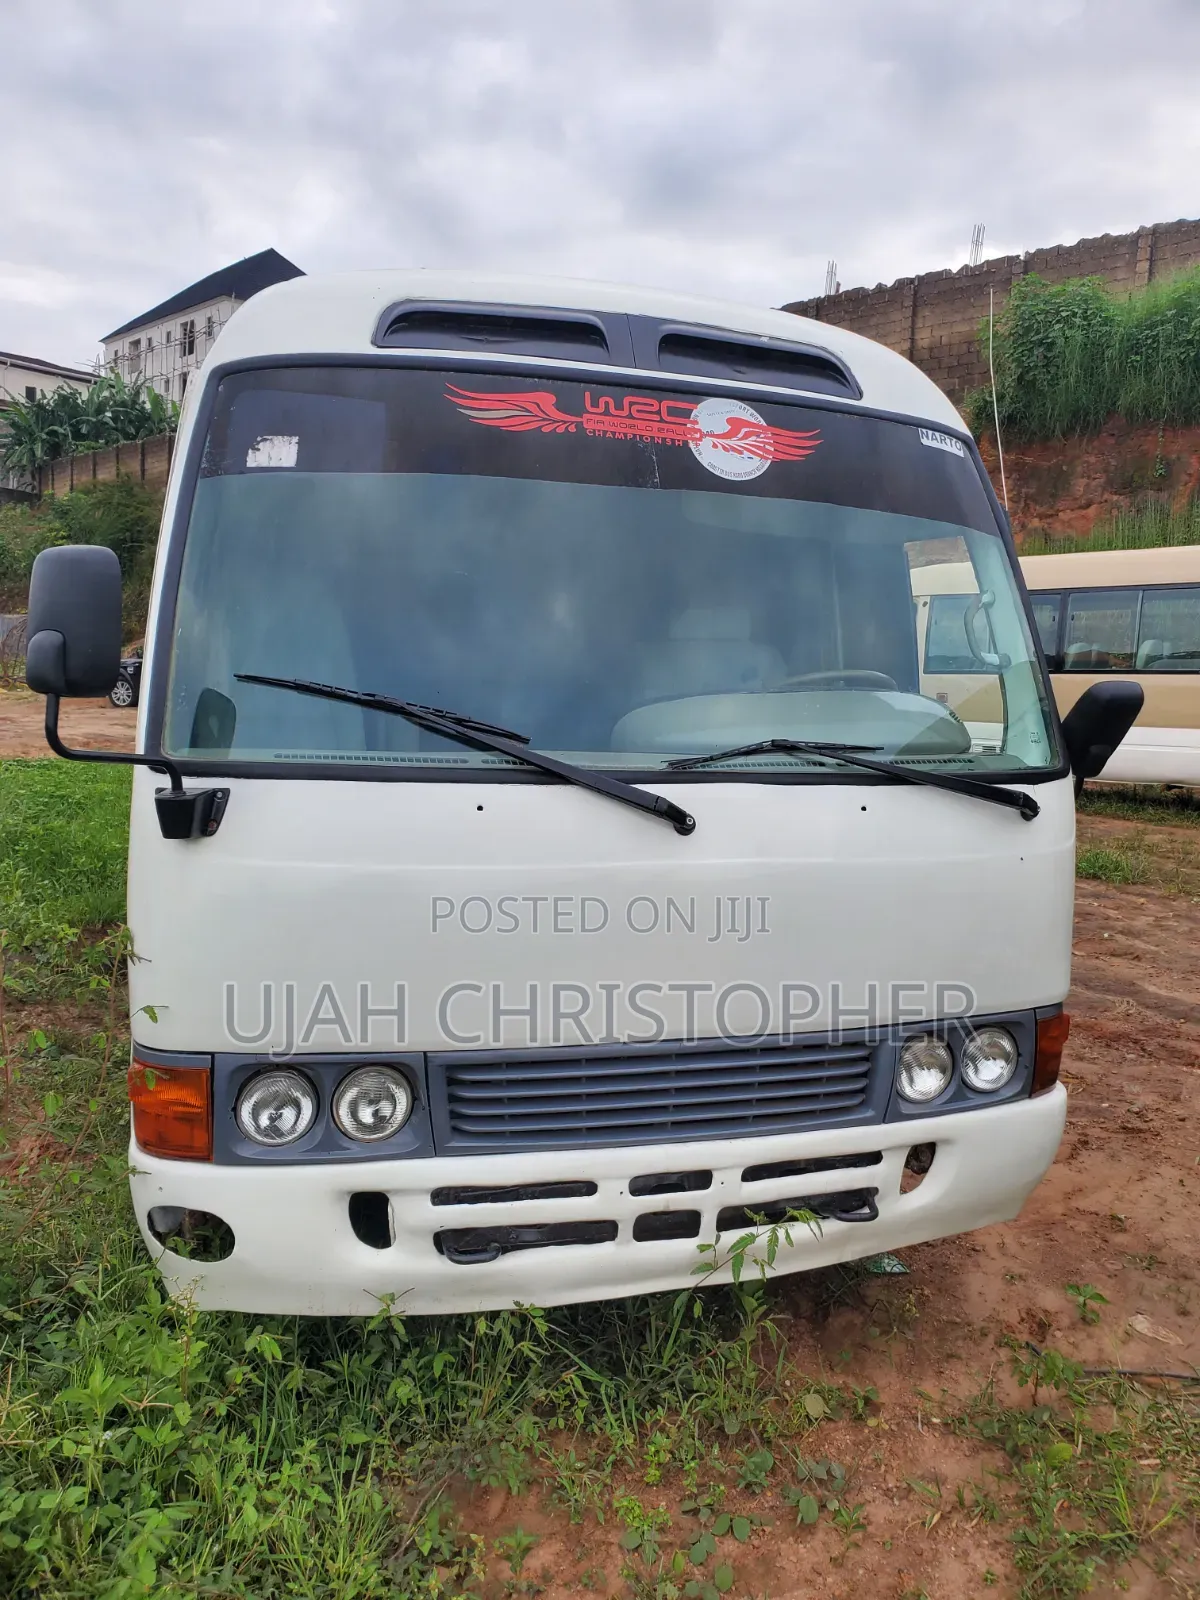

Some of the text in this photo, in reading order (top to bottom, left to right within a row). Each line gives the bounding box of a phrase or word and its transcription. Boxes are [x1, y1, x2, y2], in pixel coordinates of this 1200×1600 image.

[584, 391, 699, 425] WRC
[586, 418, 605, 426] FIA
[608, 421, 654, 432] WORLD
[920, 430, 963, 452] NARTO
